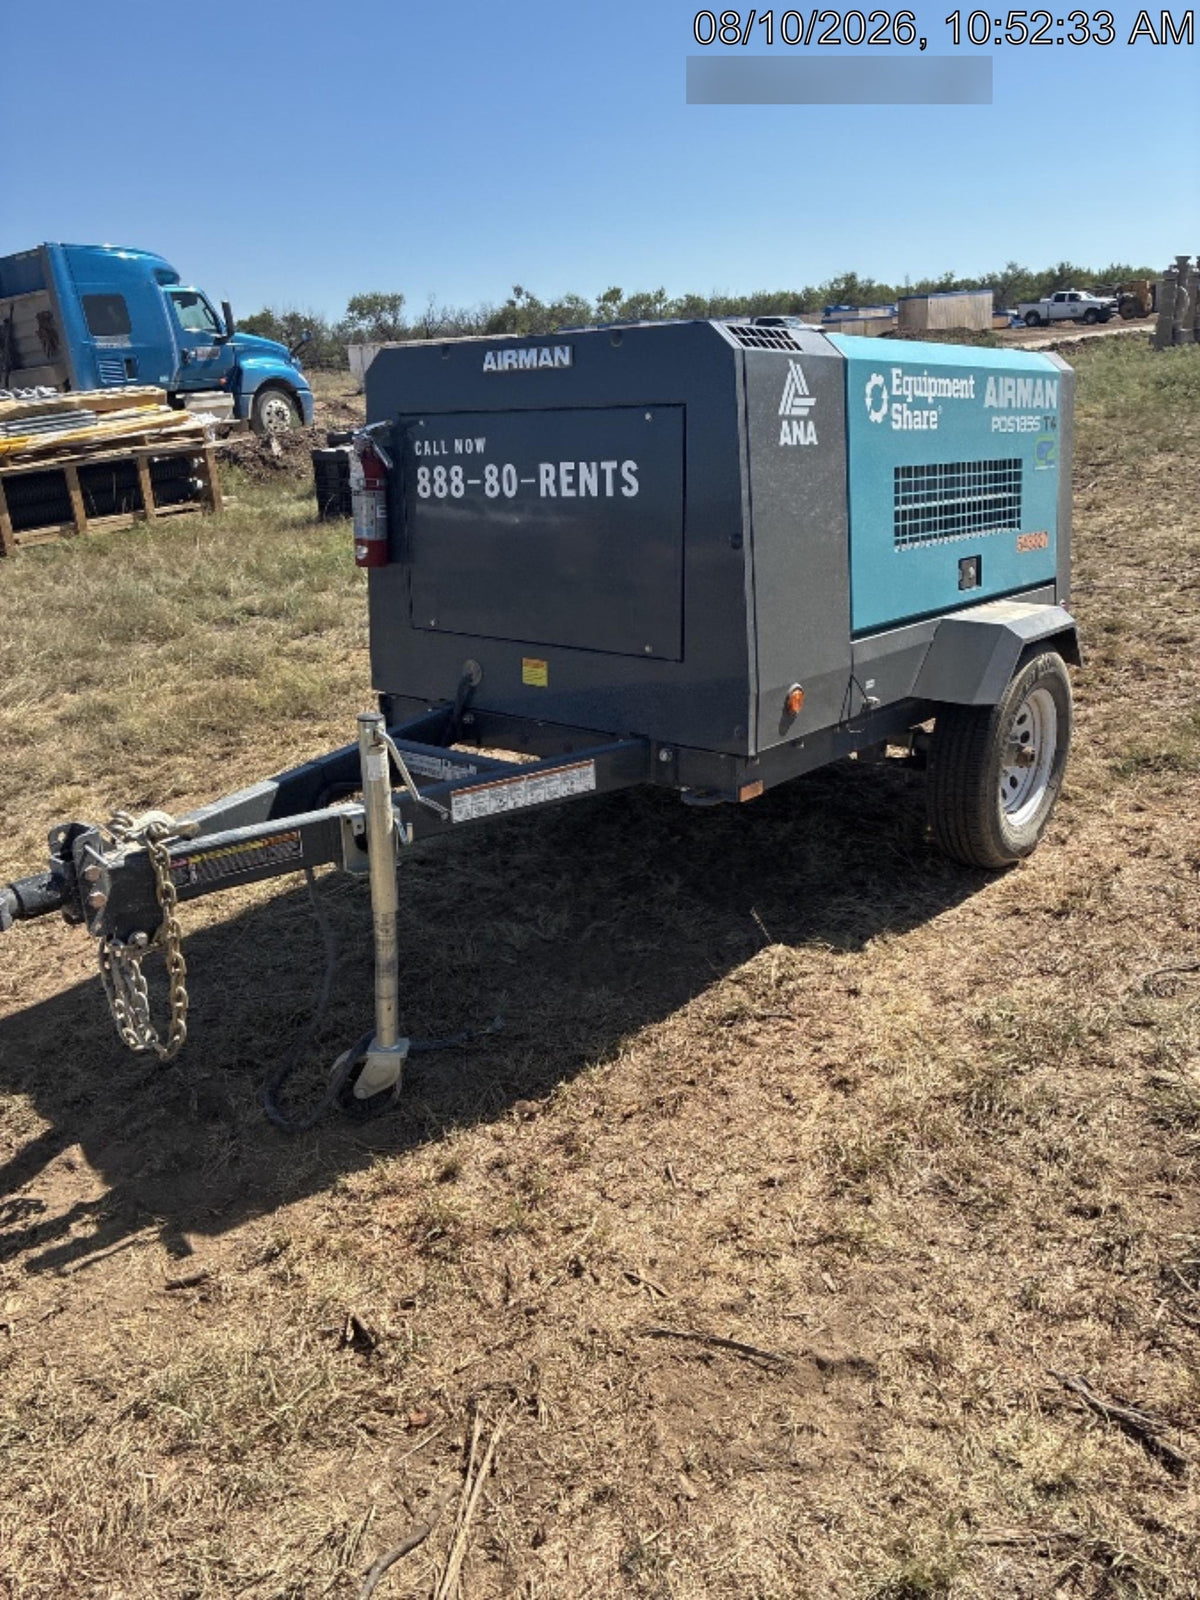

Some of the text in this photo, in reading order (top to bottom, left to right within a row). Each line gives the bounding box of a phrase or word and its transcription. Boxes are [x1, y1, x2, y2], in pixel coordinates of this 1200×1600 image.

[483, 346, 570, 372] AIRMAN
[892, 368, 975, 403] Equipment
[983, 376, 1058, 409] AIRMAN
[415, 438, 486, 455] CALL NOW
[780, 421, 818, 446] ANA
[417, 460, 640, 498] 888-80-RENTS
